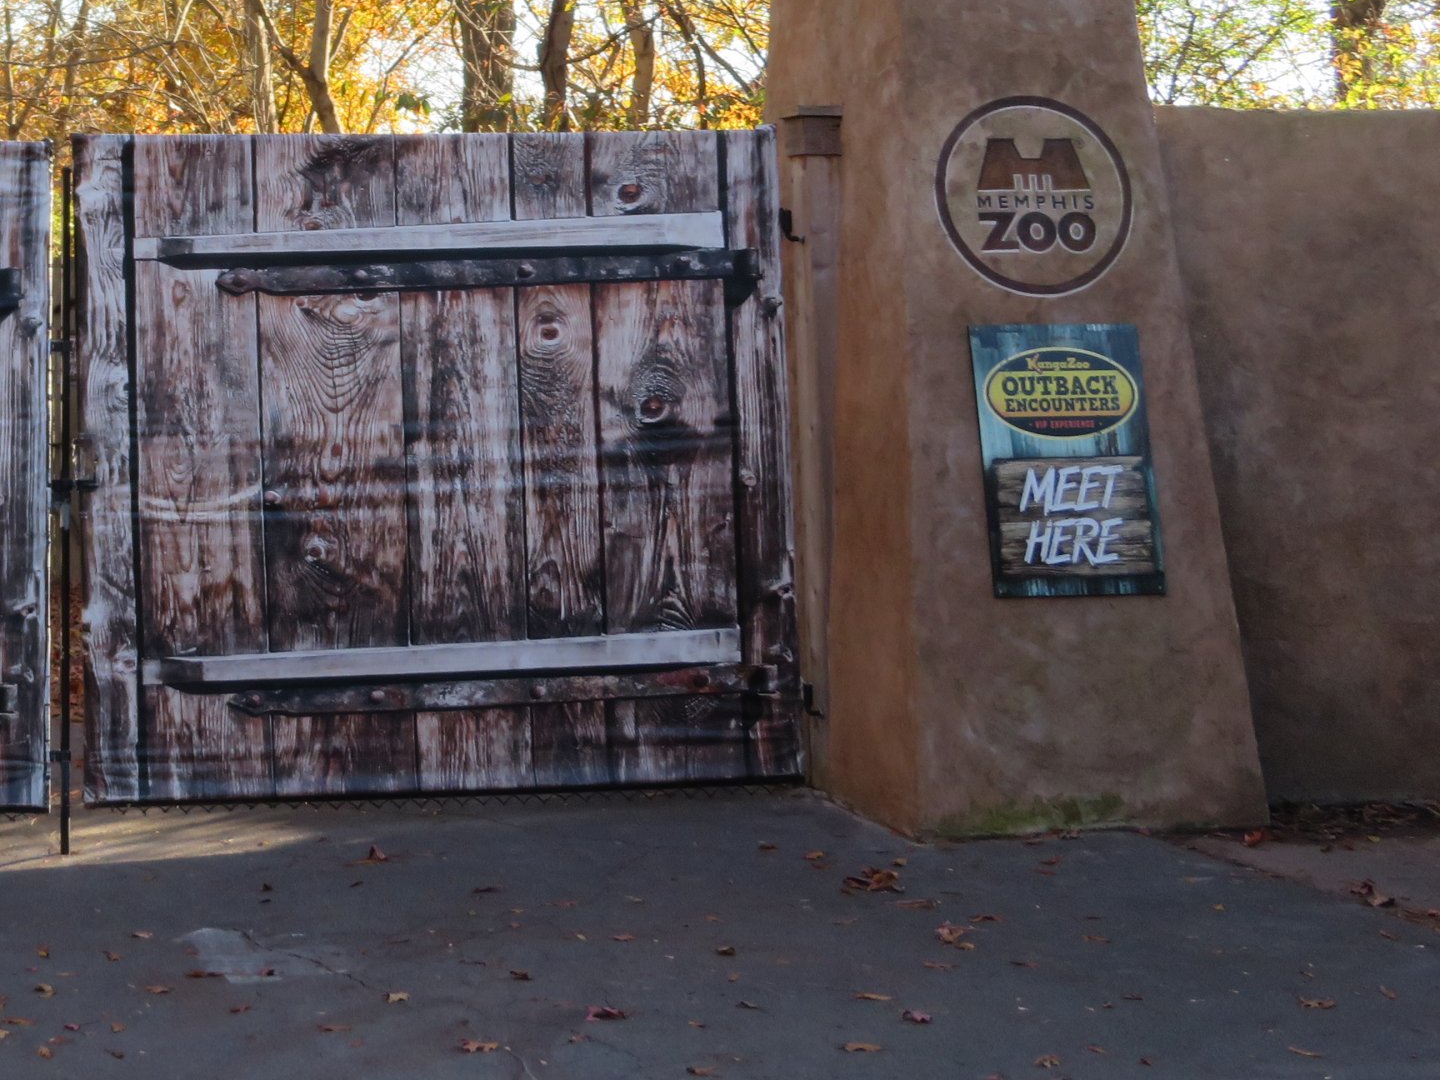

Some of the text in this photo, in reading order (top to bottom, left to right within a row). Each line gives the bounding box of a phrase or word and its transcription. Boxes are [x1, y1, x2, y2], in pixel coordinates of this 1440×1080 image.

[977, 195, 1095, 210] MEMPHIS
[978, 211, 1096, 252] ZOO
[1025, 353, 1090, 375] KangaZoo
[1001, 375, 1118, 396] OUTBACK
[1005, 396, 1121, 412] ENCOUNTERS
[1020, 464, 1124, 516] MEET
[1024, 517, 1124, 569] HERE
